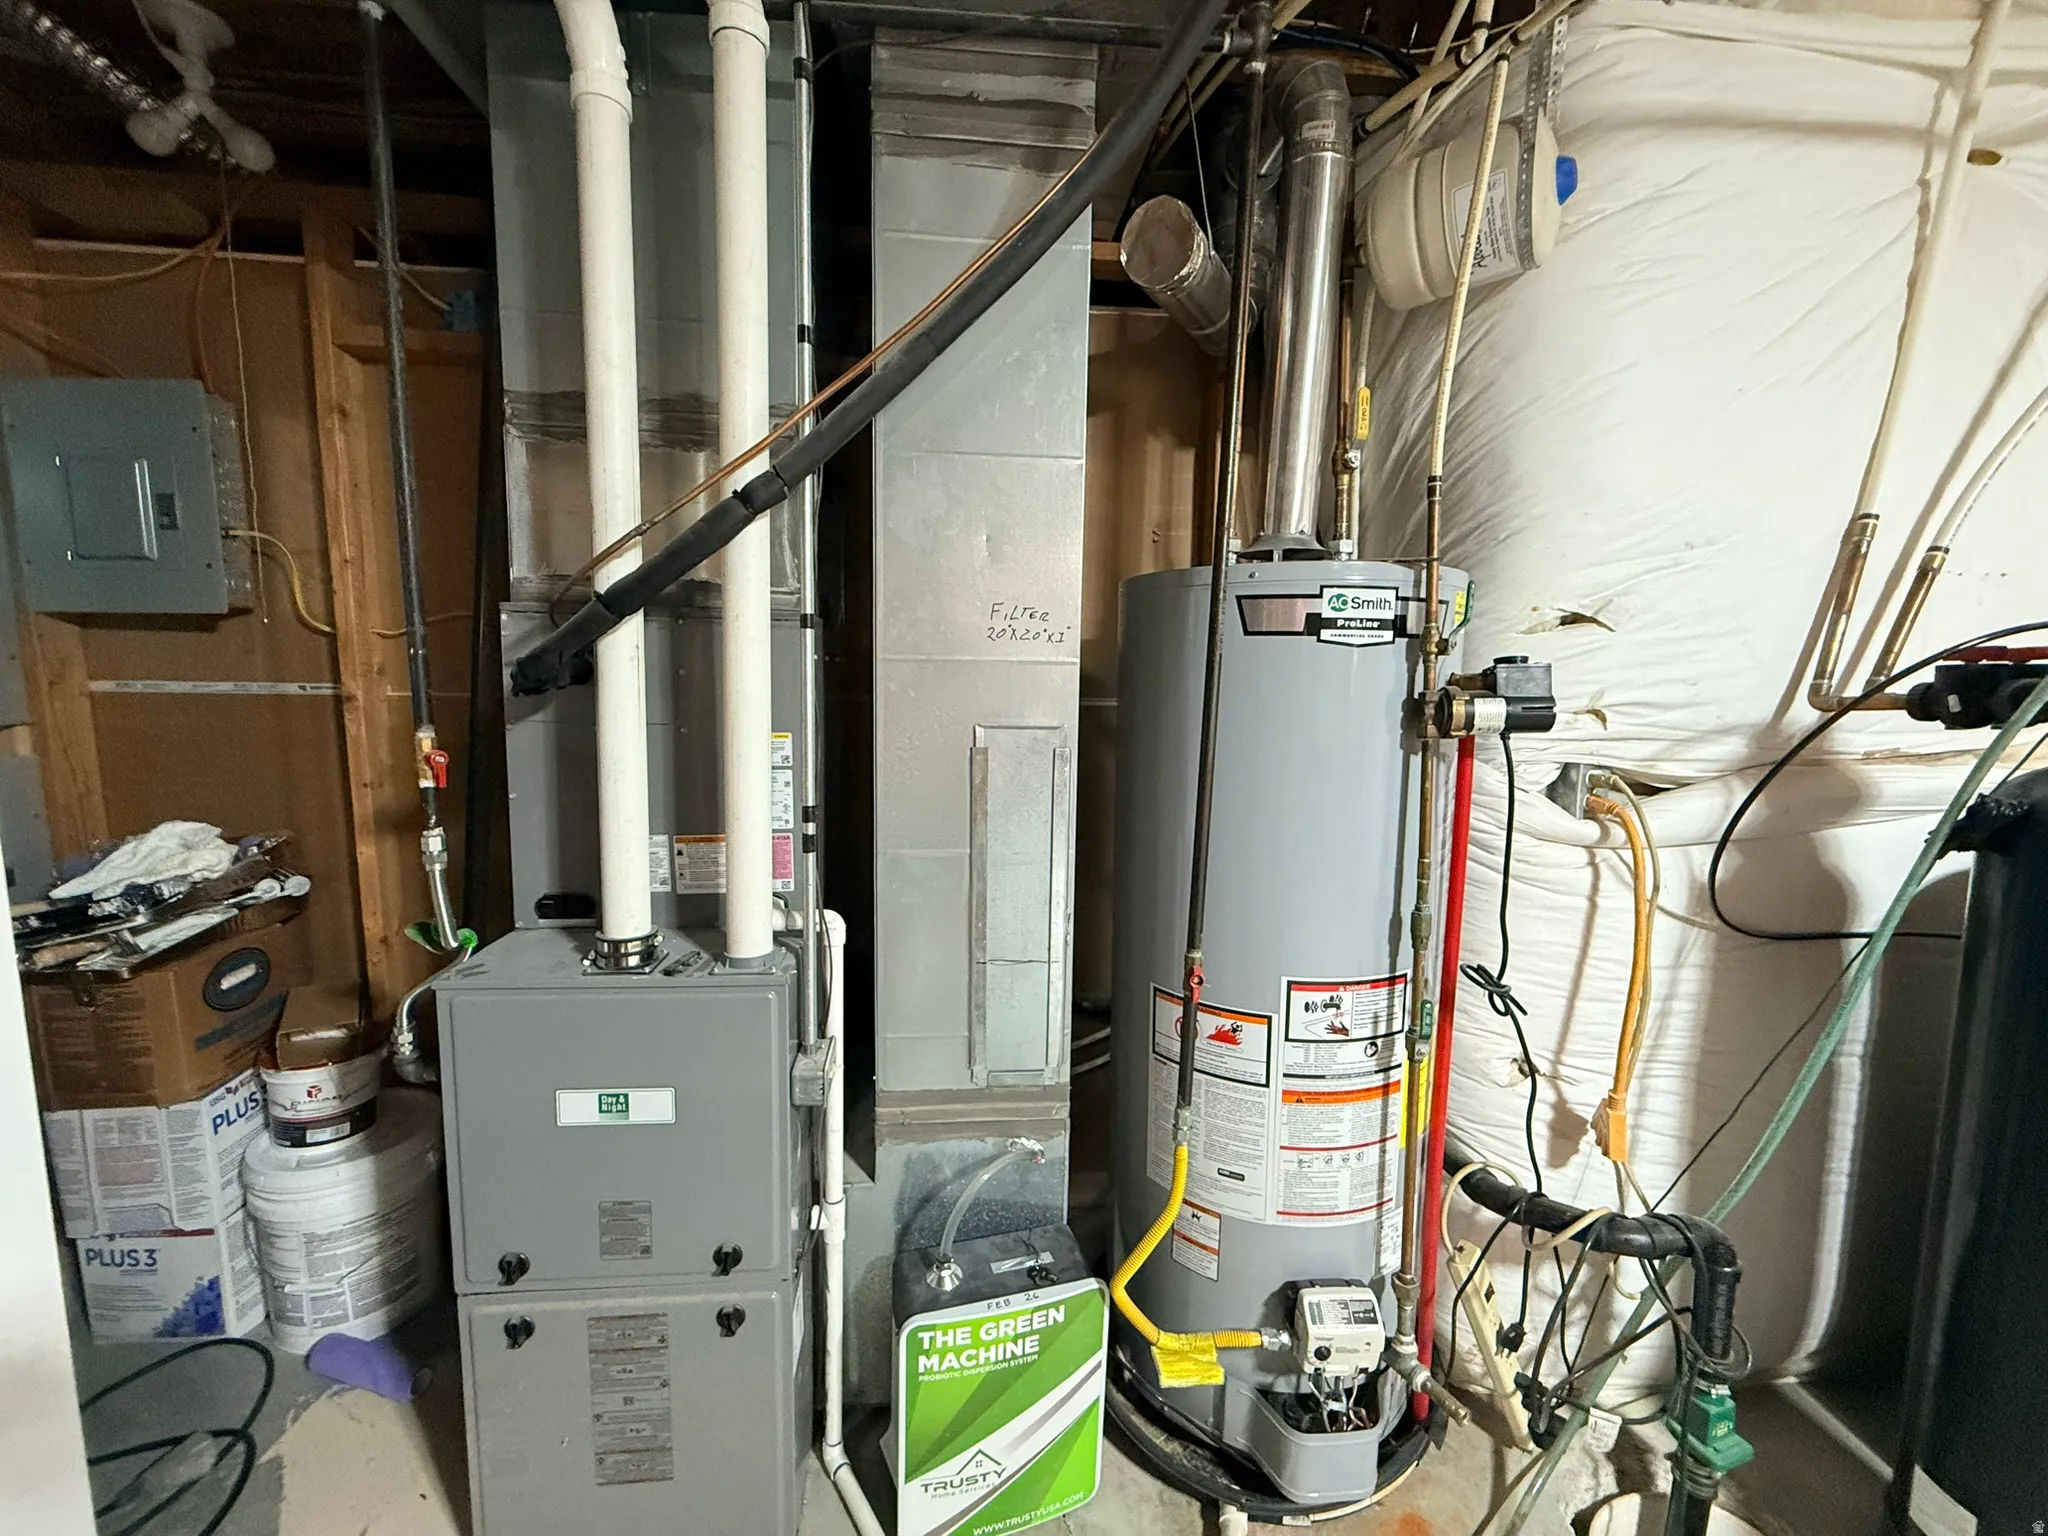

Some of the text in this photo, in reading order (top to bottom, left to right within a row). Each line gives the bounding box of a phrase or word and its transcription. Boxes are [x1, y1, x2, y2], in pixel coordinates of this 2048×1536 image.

[990, 602, 1049, 621] FILTER
[601, 1103, 626, 1112] Night
[602, 1095, 625, 1105] Day &
[212, 1091, 260, 1136] PLUS
[85, 1249, 157, 1267] PLUS 3
[987, 1299, 1011, 1310] FEB
[918, 1305, 1065, 1350] THE GREEN
[918, 1334, 1040, 1373] MACHINE
[918, 1354, 1038, 1382] PROBIOTIC DISPERSION SYSTEM
[920, 1467, 1007, 1493] TRUSTY
[931, 1490, 956, 1500] Home
[973, 1491, 1084, 1536] WWW.TRUSTYUSA.COM
